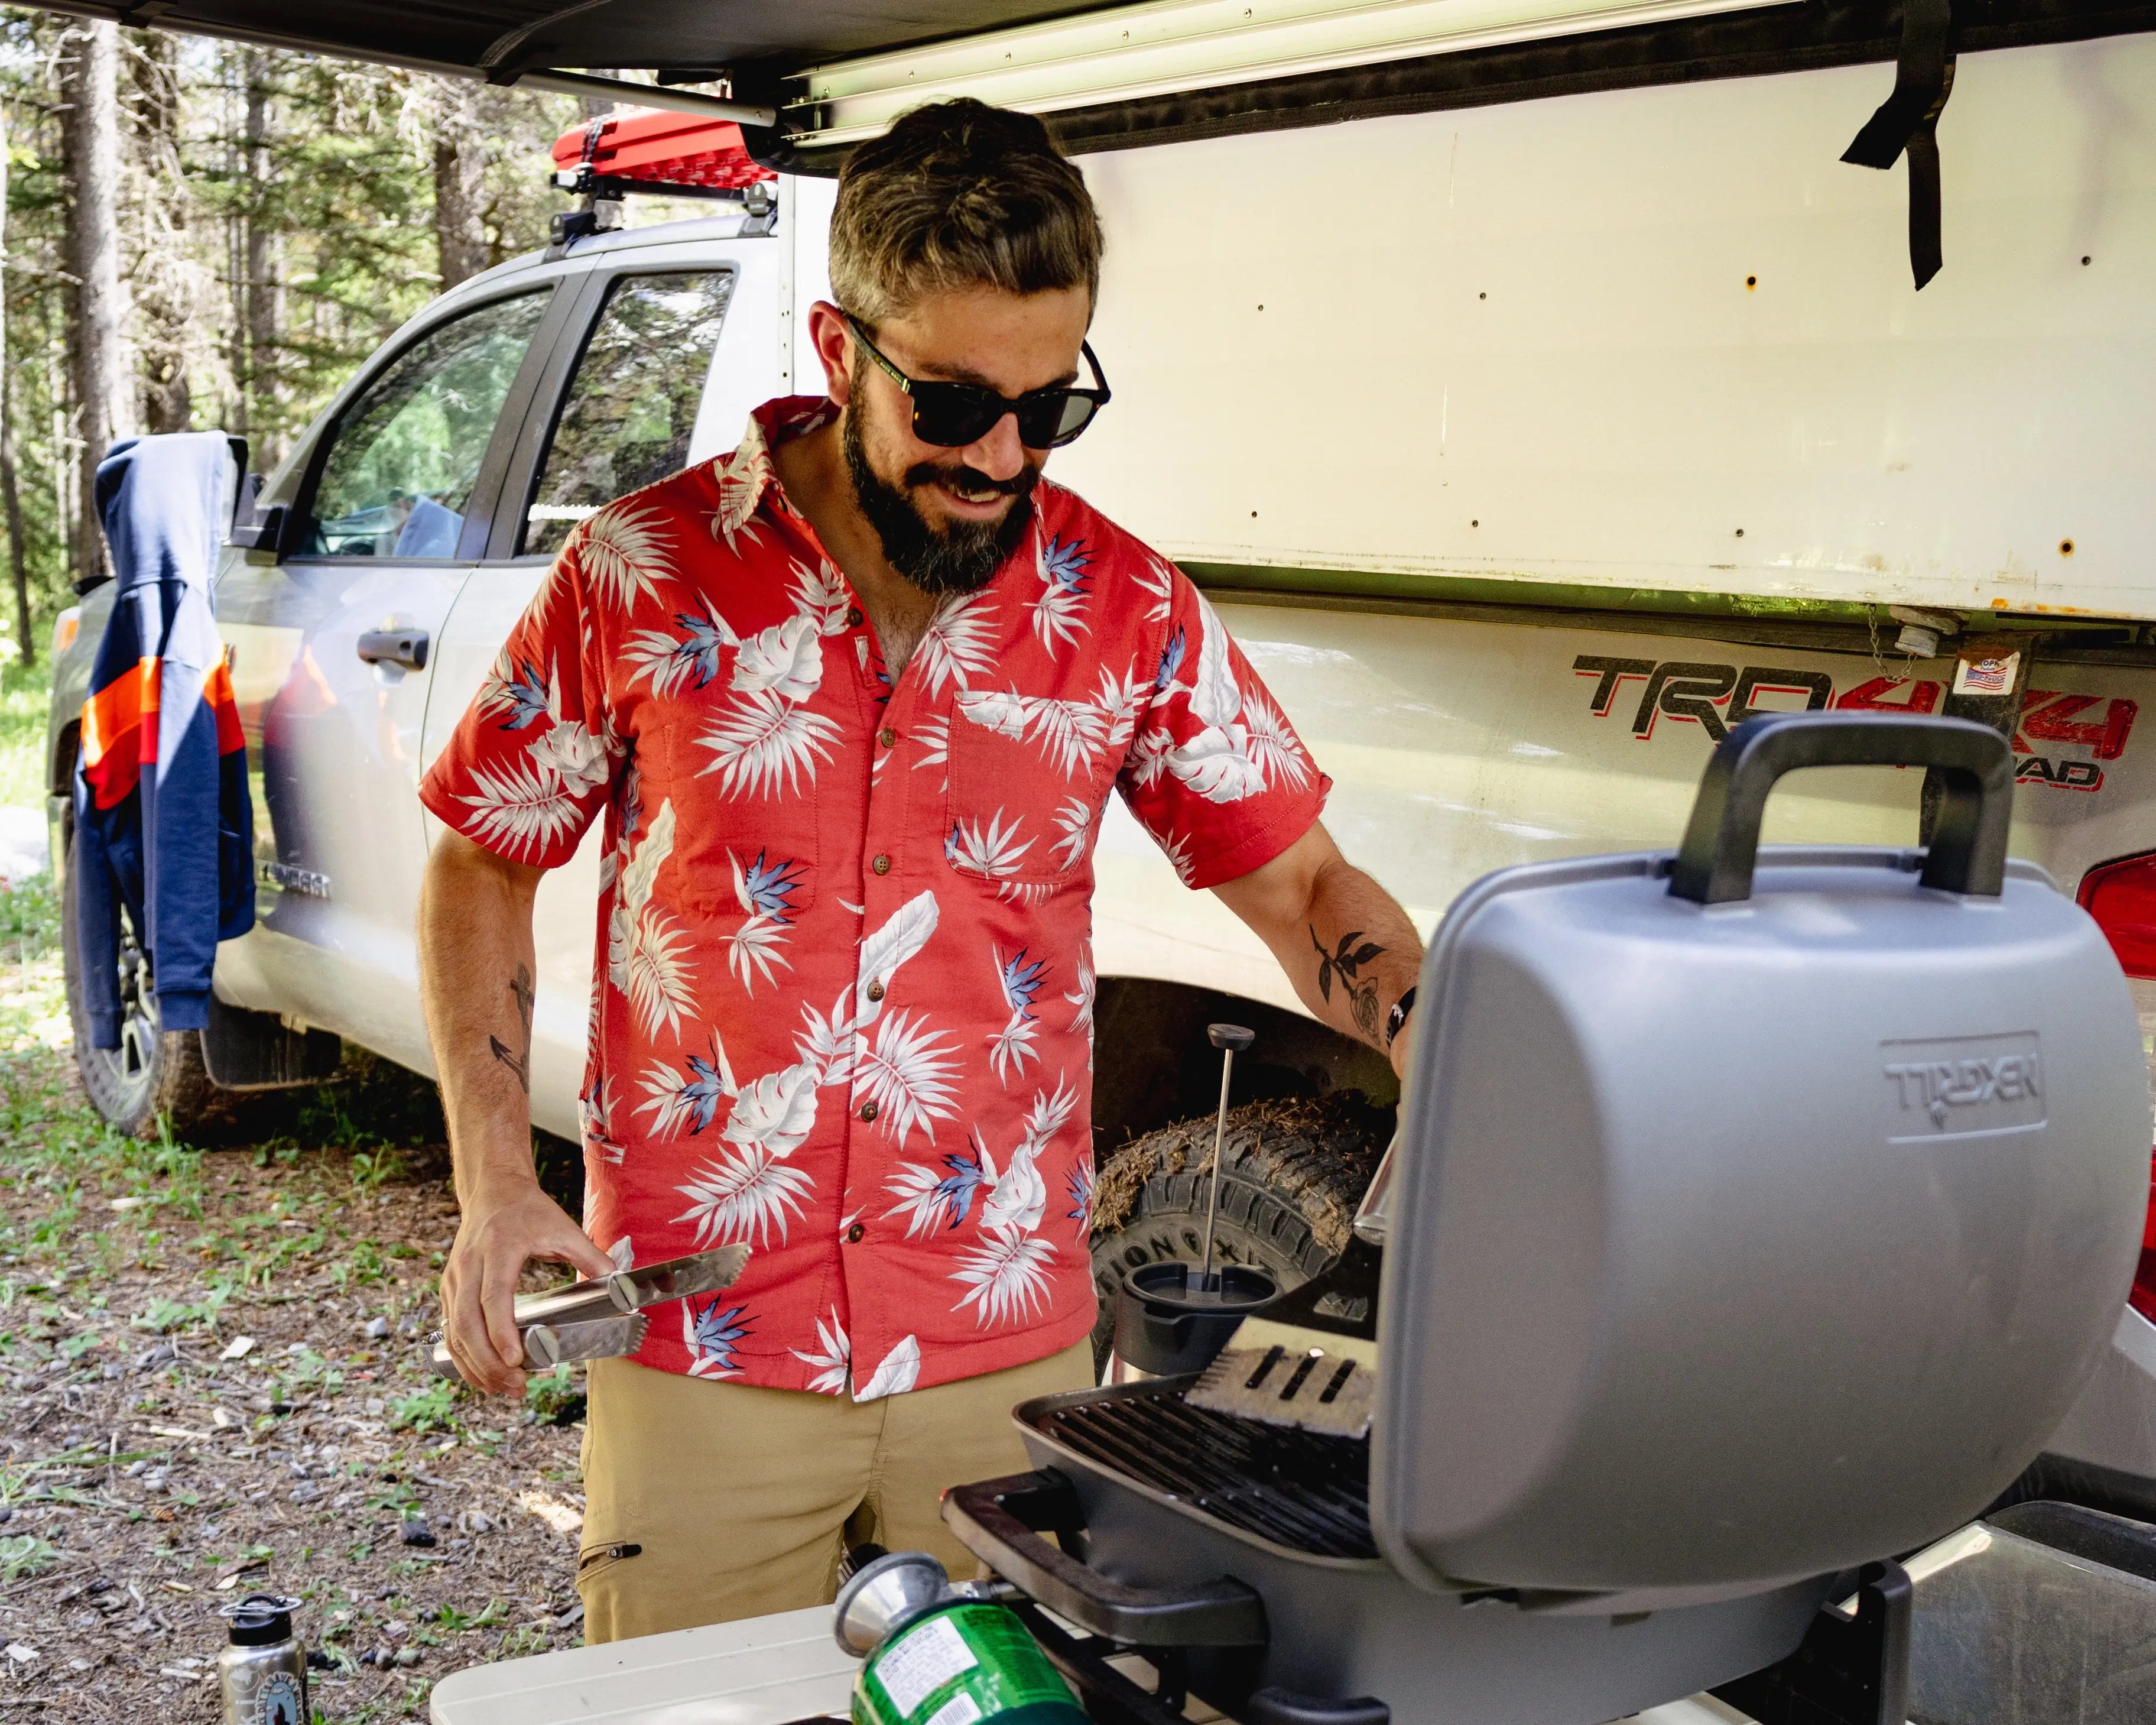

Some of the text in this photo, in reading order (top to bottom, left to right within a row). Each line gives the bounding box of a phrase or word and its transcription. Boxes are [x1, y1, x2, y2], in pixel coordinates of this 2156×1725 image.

[1572, 654, 2139, 760] TRD 44
[2009, 756, 2104, 791] AD
